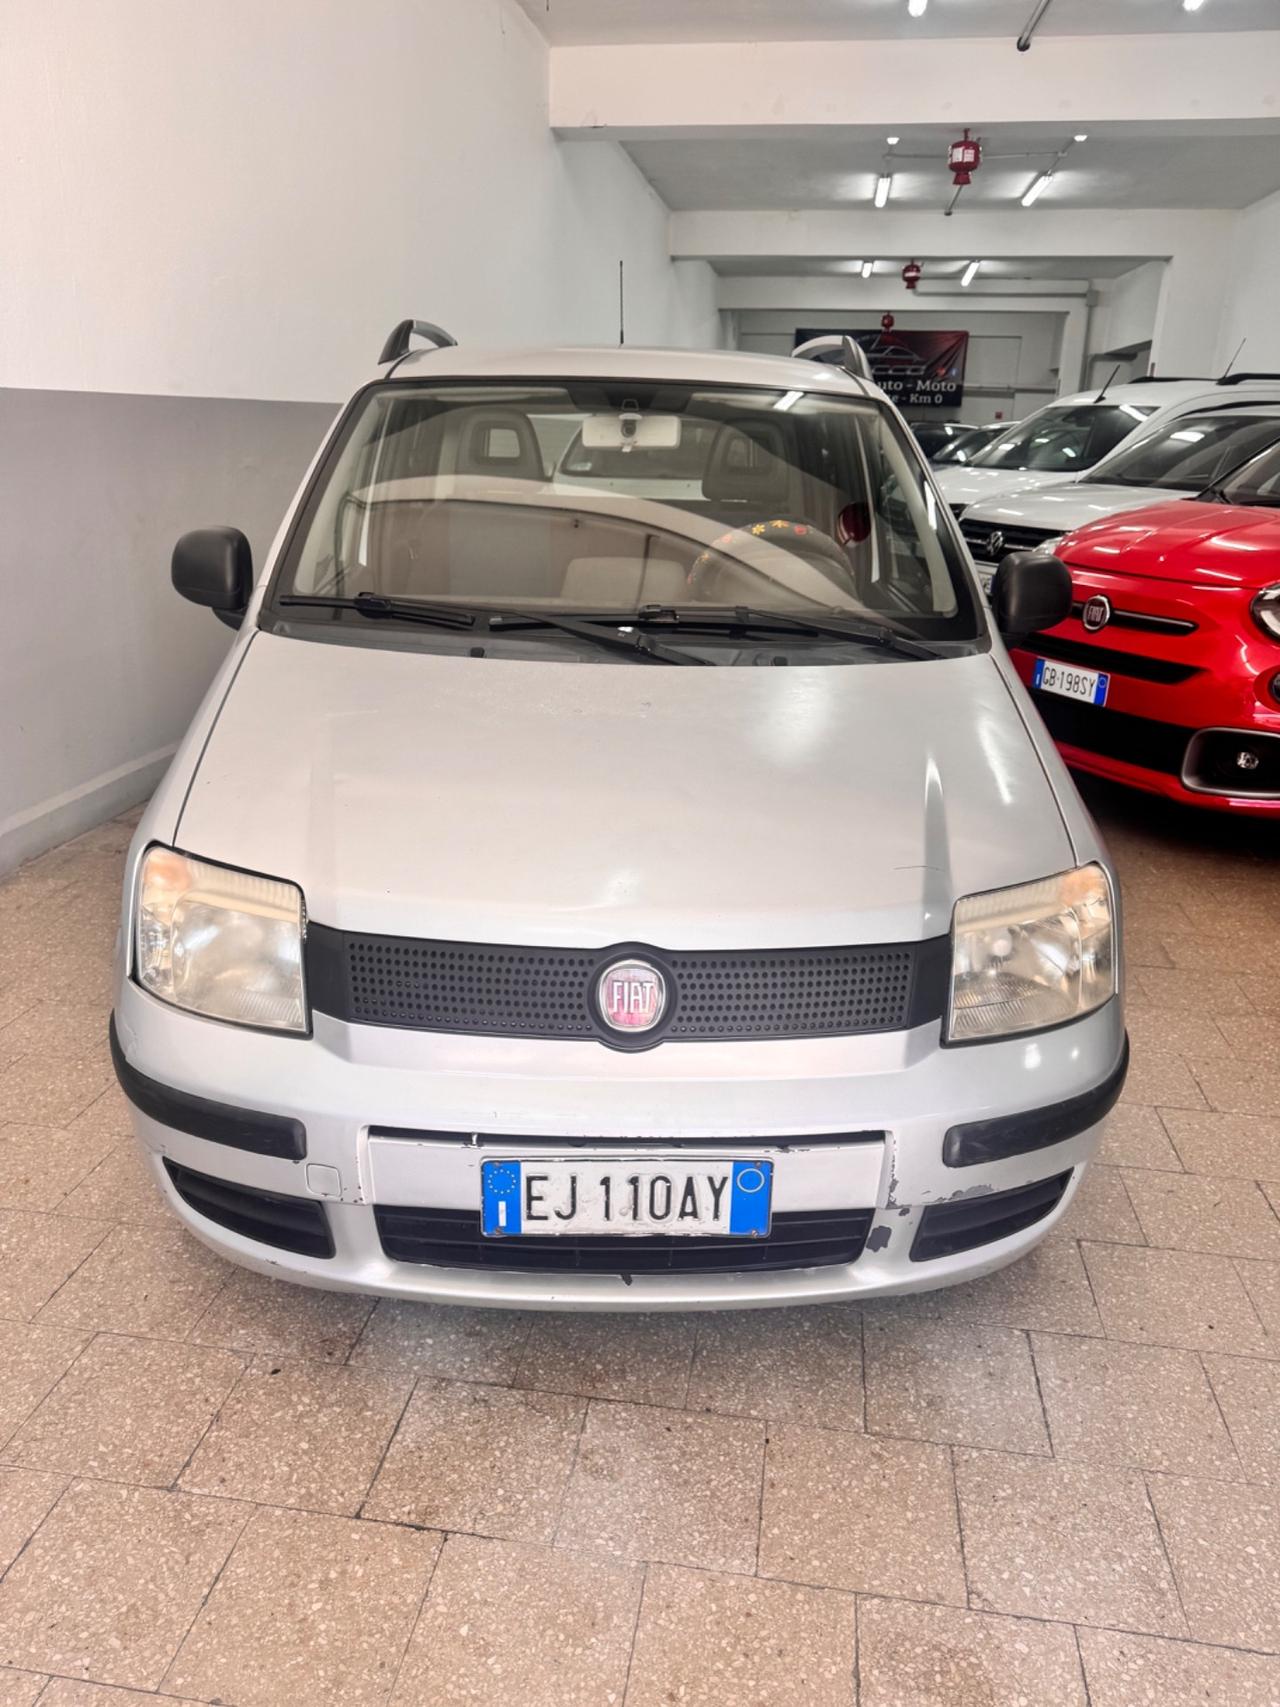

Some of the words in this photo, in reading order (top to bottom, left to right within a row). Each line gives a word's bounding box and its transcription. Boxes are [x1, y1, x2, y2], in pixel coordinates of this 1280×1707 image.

[878, 381, 903, 391] uto
[916, 380, 956, 392] Moto
[909, 393, 931, 404] Km
[612, 981, 654, 1013] FIAT
